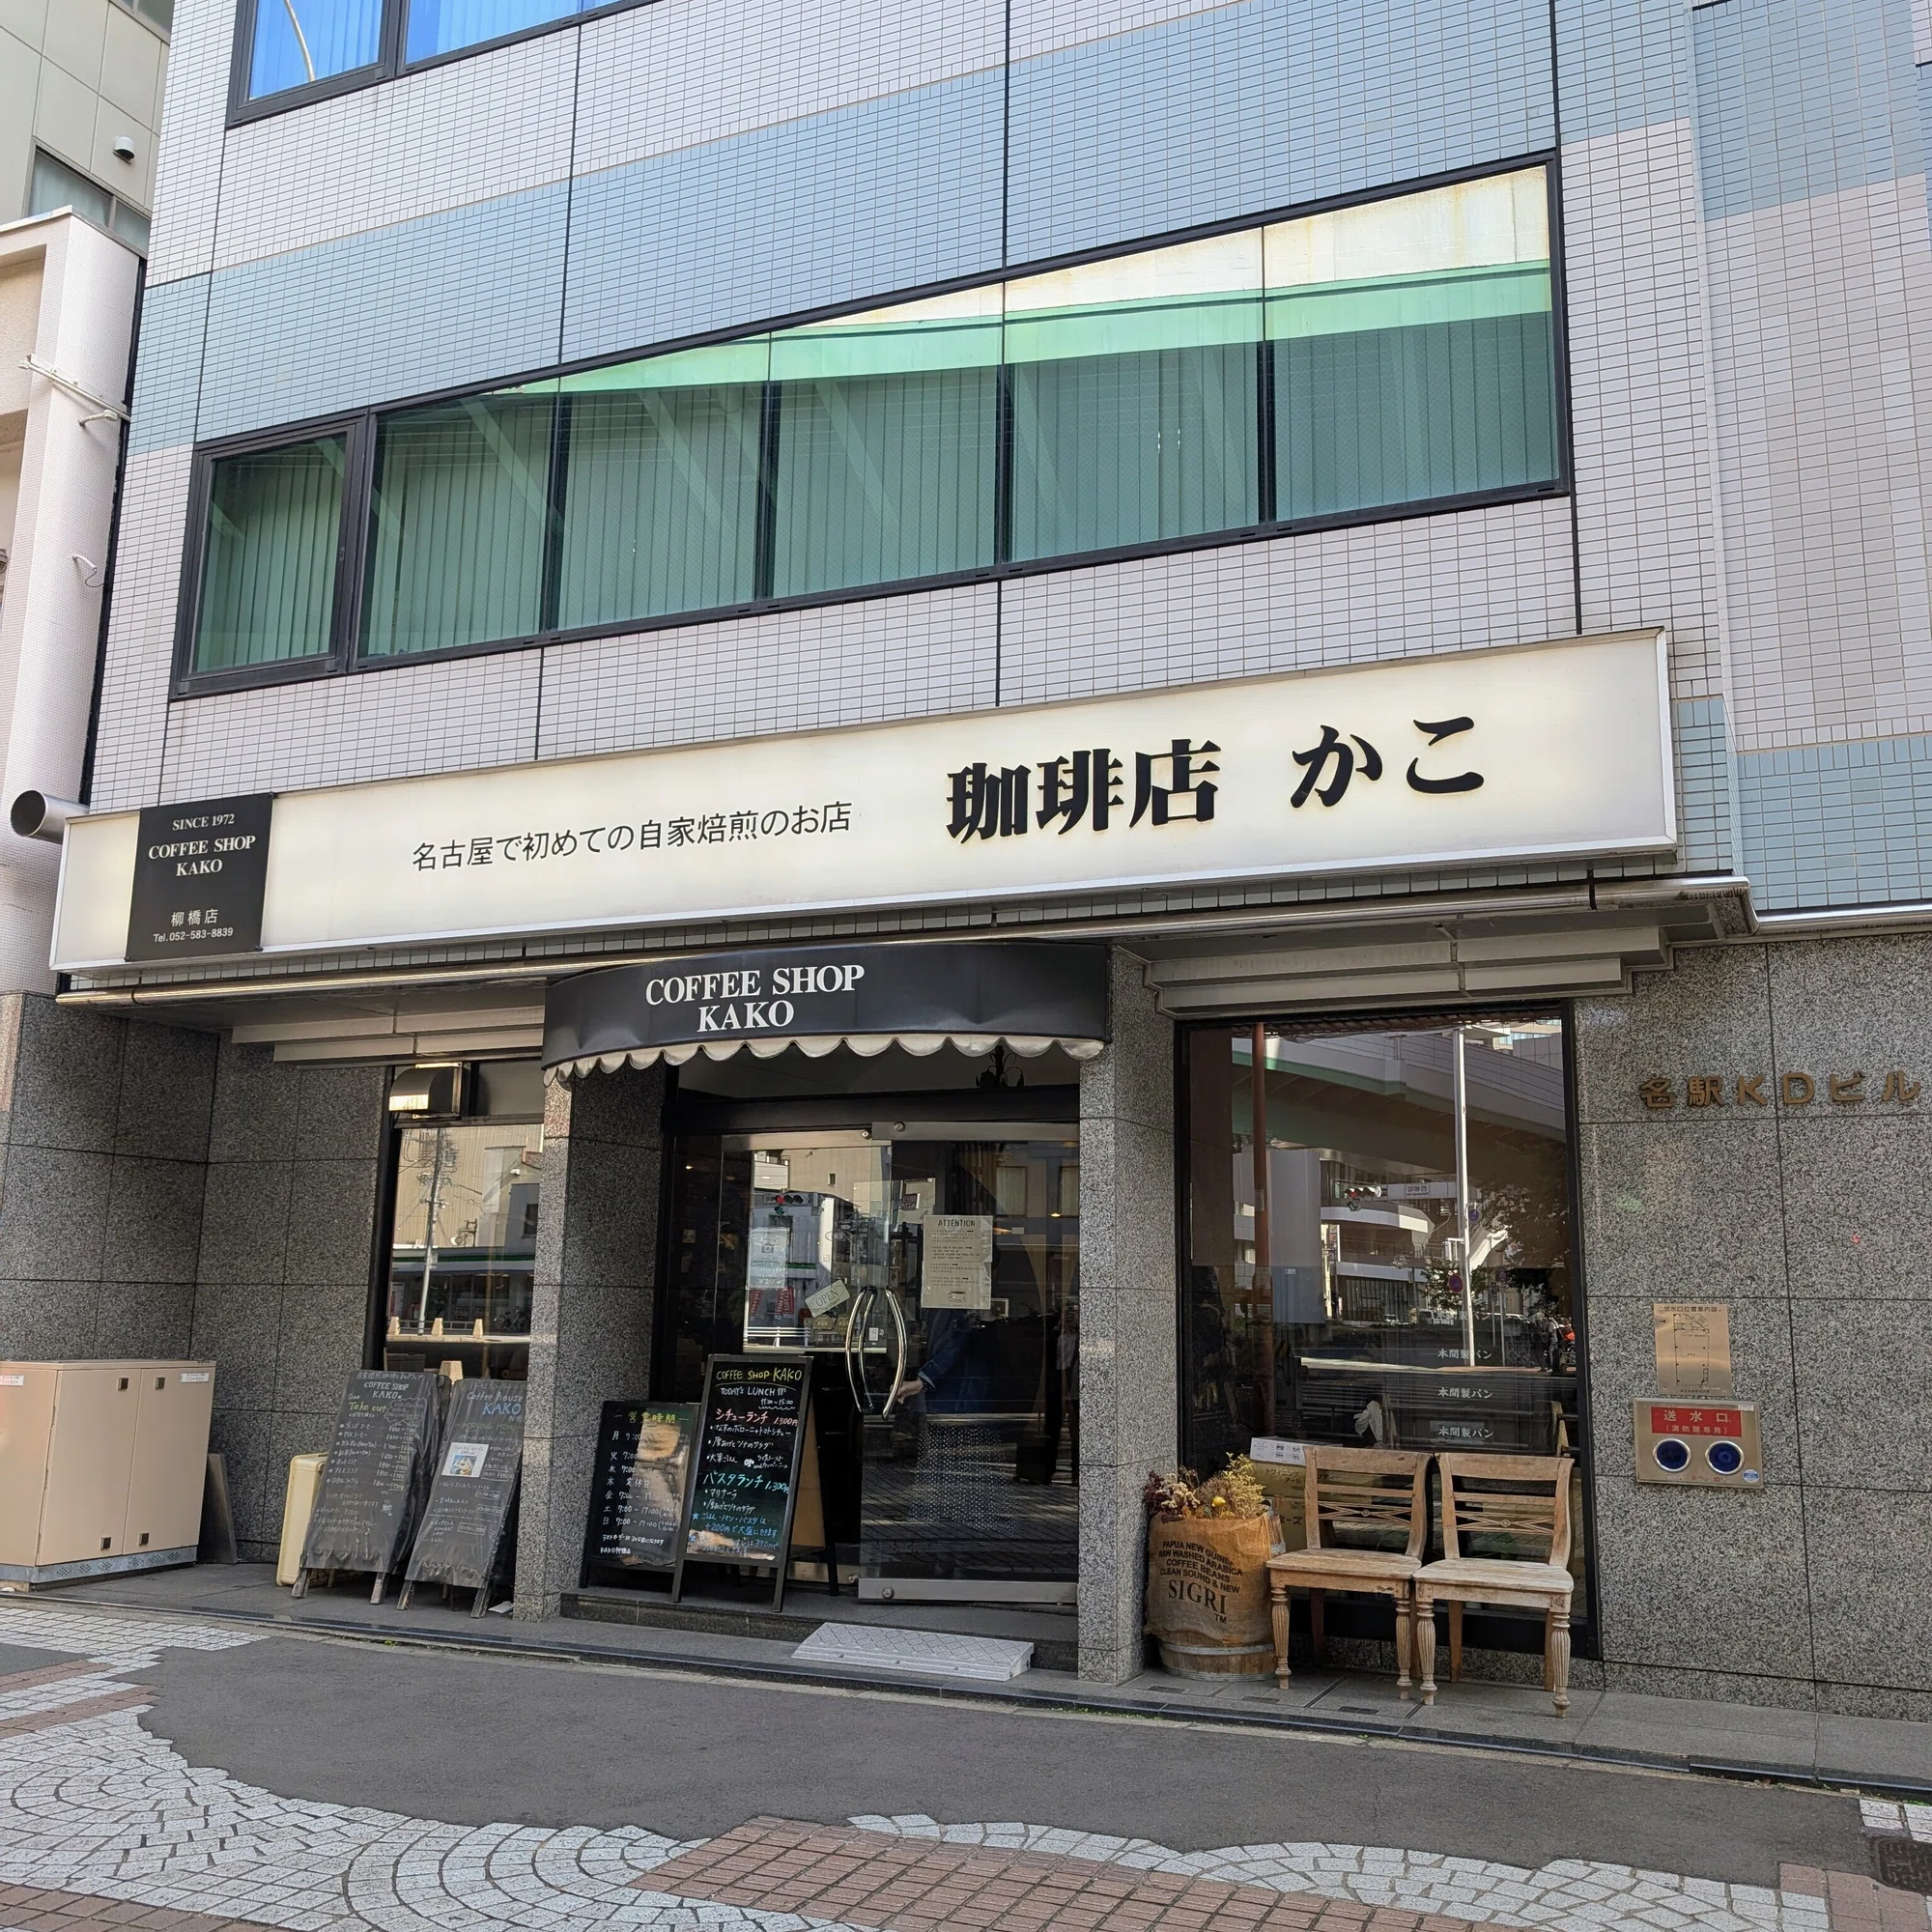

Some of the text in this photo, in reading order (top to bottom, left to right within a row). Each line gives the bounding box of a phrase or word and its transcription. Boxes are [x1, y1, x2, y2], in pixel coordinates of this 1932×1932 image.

[946, 716, 1485, 844] 珈琲店 かこ
[172, 813, 235, 831] SINCE 1972
[412, 801, 852, 871] 名古屋で初めての自家焙煎のお店
[148, 835, 256, 859] COFFEE SHOP
[175, 859, 223, 877] KAKO
[170, 908, 218, 927] 柳橋店
[153, 927, 234, 943] Tel.052-583-8839
[645, 964, 865, 1006] COFFEE SHOP
[696, 999, 795, 1033] KAKO
[1640, 1069, 1920, 1109] 名駅KDビル
[816, 1288, 839, 1307] OPEN
[716, 1367, 802, 1382] COFFEE SHOP KAKO
[364, 1381, 391, 1390] COFFEE
[747, 1387, 775, 1396] LUNCH
[1438, 1387, 1493, 1399] 本間製パン
[349, 1401, 369, 1411] Take
[483, 1402, 521, 1415] KAKO
[628, 1411, 675, 1424] 営業時間
[716, 1408, 768, 1424] シチューランチ
[1663, 1410, 1728, 1422] 送水口
[612, 1431, 619, 1440] 月
[1438, 1426, 1494, 1438] 本間製パン
[744, 1458, 754, 1467] or
[607, 1477, 649, 1487] 木 定休日
[703, 1471, 763, 1488] パスタランチ
[605, 1490, 613, 1499] 金
[1186, 1543, 1204, 1553] NEW
[1167, 1559, 1230, 1583] COFFEE BEANS
[1173, 1550, 1205, 1563] WASHED
[1207, 1559, 1243, 1576] ARABICA
[1183, 1569, 1210, 1584] SOUND
[1213, 1580, 1219, 1588] &
[1221, 1585, 1241, 1594] NEW
[1168, 1579, 1227, 1615] SIGRI
[1214, 1614, 1227, 1624] TM
